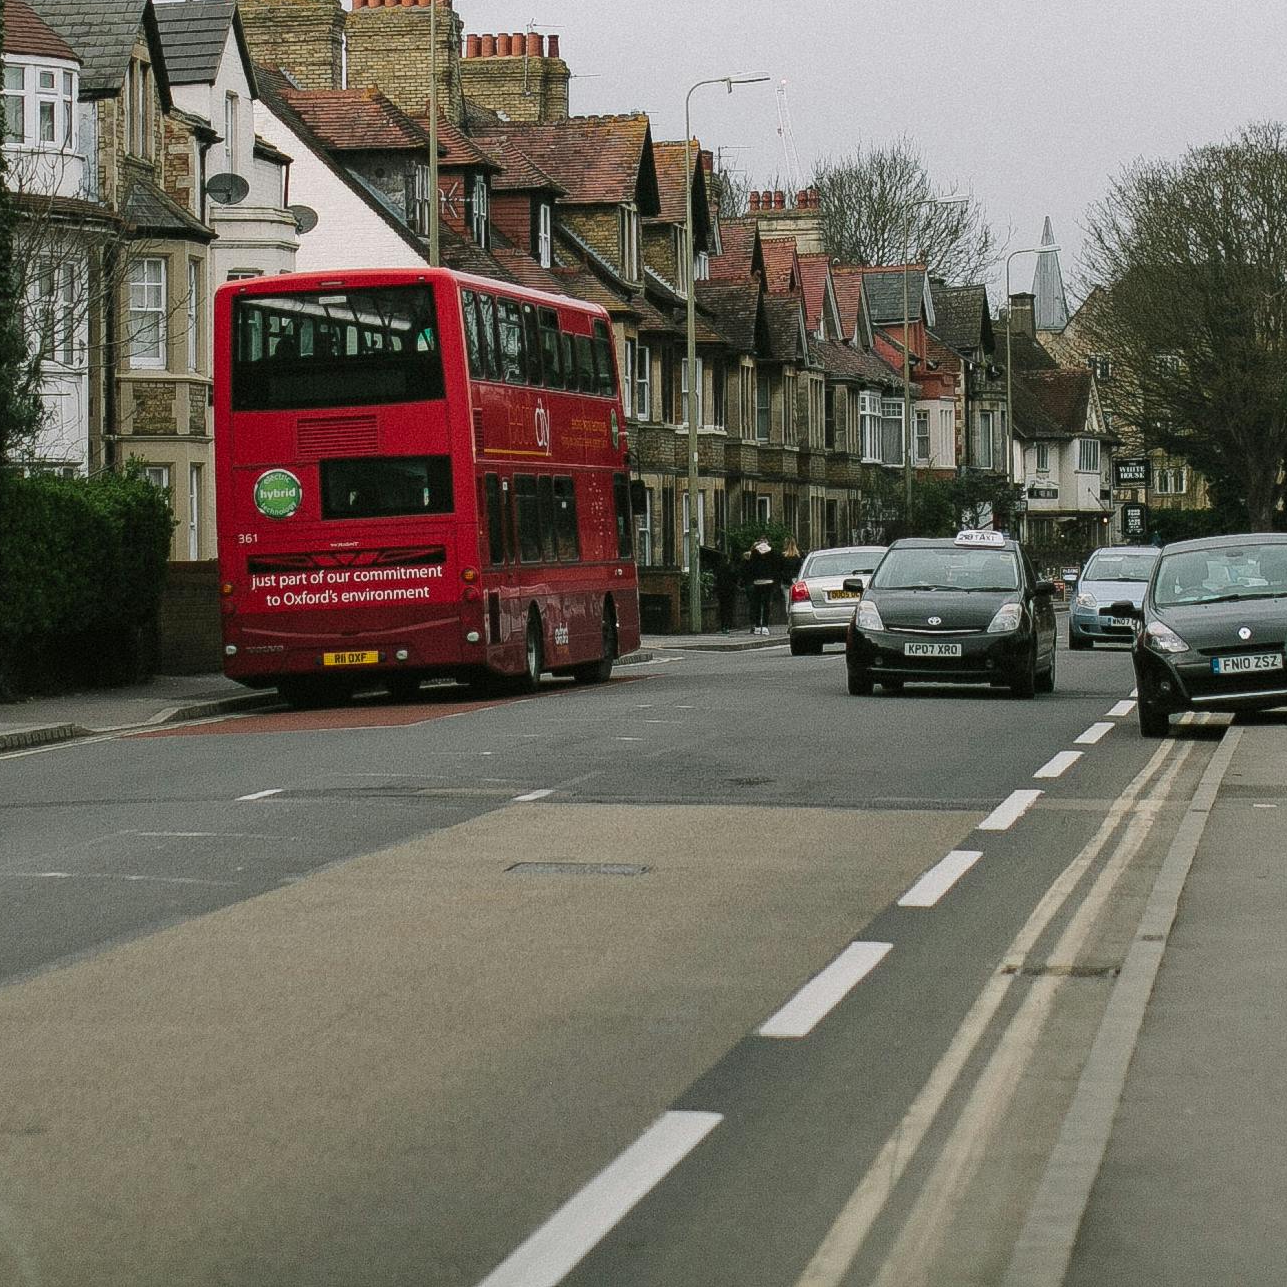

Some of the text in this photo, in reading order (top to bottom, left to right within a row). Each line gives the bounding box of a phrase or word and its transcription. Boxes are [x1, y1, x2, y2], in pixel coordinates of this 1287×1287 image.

[264, 473, 291, 485] electric
[260, 488, 296, 501] hybrid
[260, 501, 297, 515] technology
[238, 534, 258, 544] 361
[975, 533, 994, 541] TAXI
[252, 565, 443, 590] just part of our commitment
[266, 586, 430, 606] to Oxford's environment
[908, 644, 958, 655] KP07 XRO
[348, 653, 367, 663] OXF
[1223, 656, 1279, 671] FN10 ZSZ
